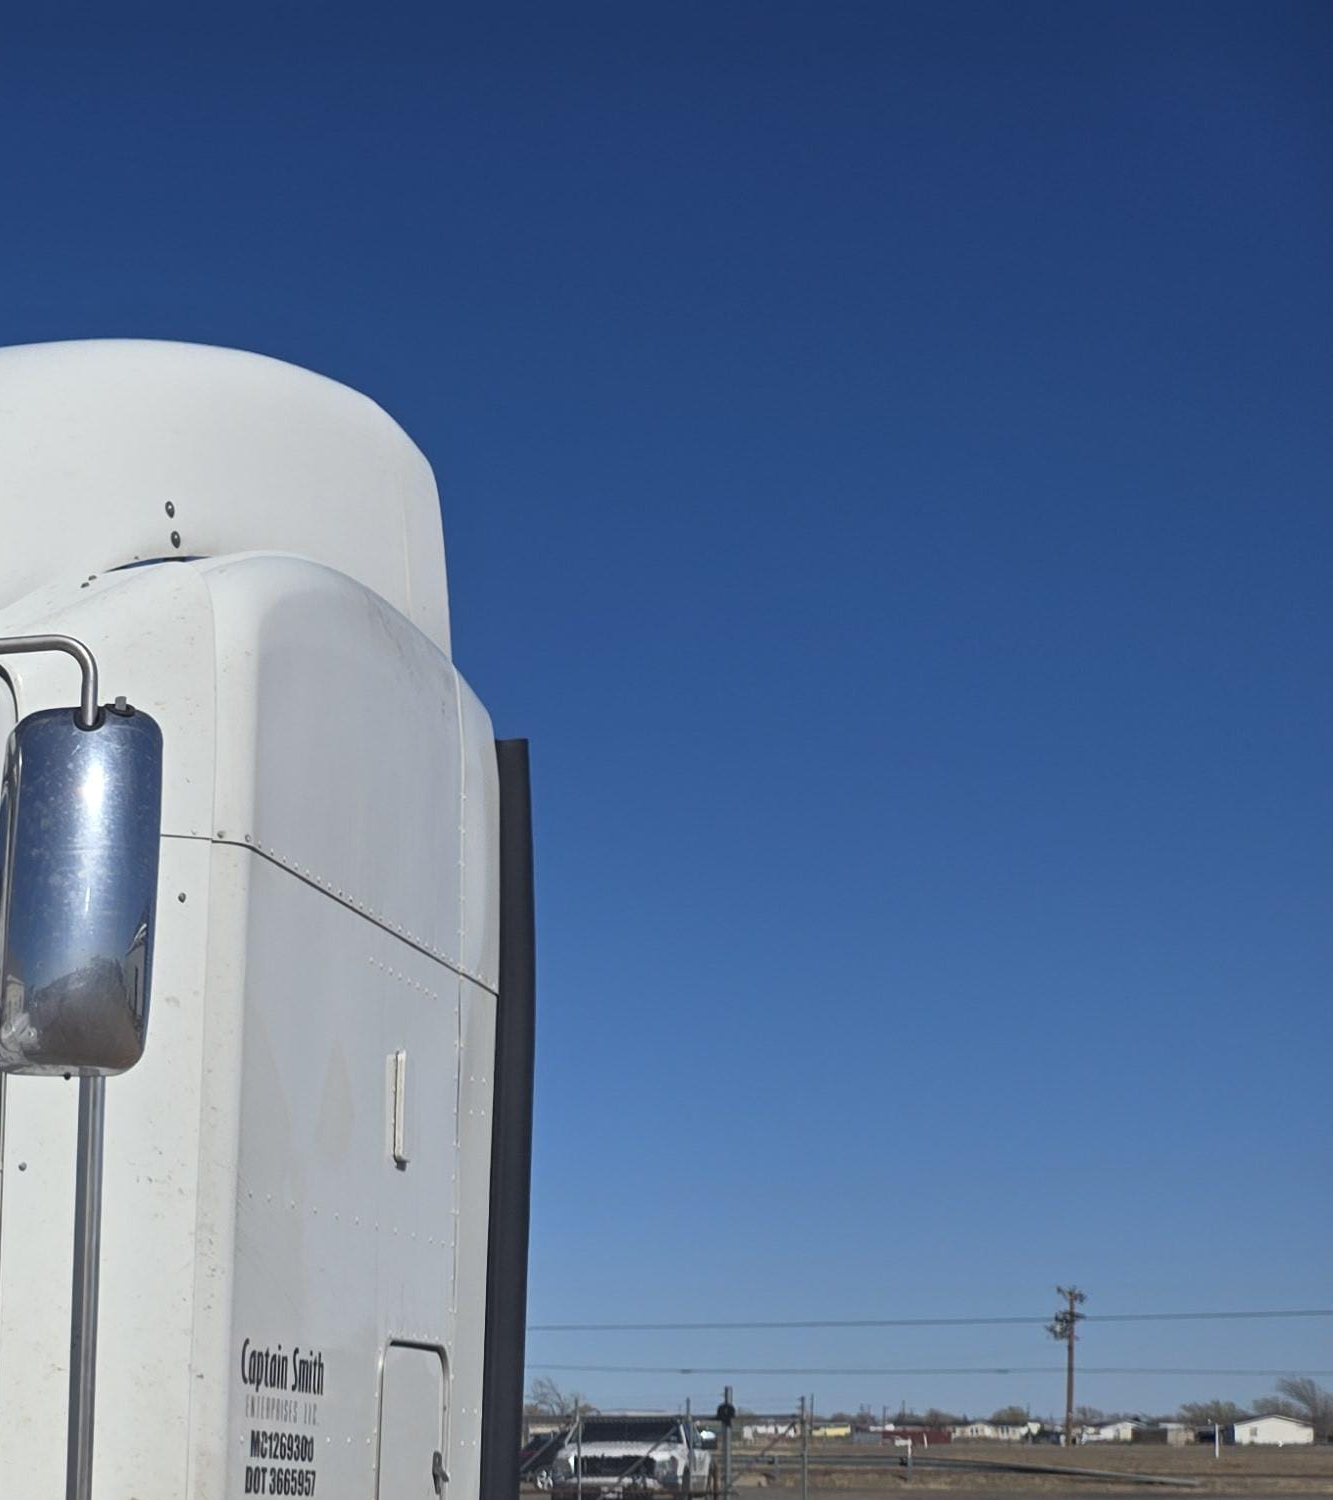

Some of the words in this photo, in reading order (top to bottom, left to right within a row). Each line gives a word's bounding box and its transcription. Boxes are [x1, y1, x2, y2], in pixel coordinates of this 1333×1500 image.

[241, 1337, 288, 1393] Captain
[291, 1346, 324, 1396] Smith
[245, 1394, 298, 1424] ENTERPRISES
[245, 1466, 267, 1495] DOT
[269, 1467, 316, 1497] 3665957
